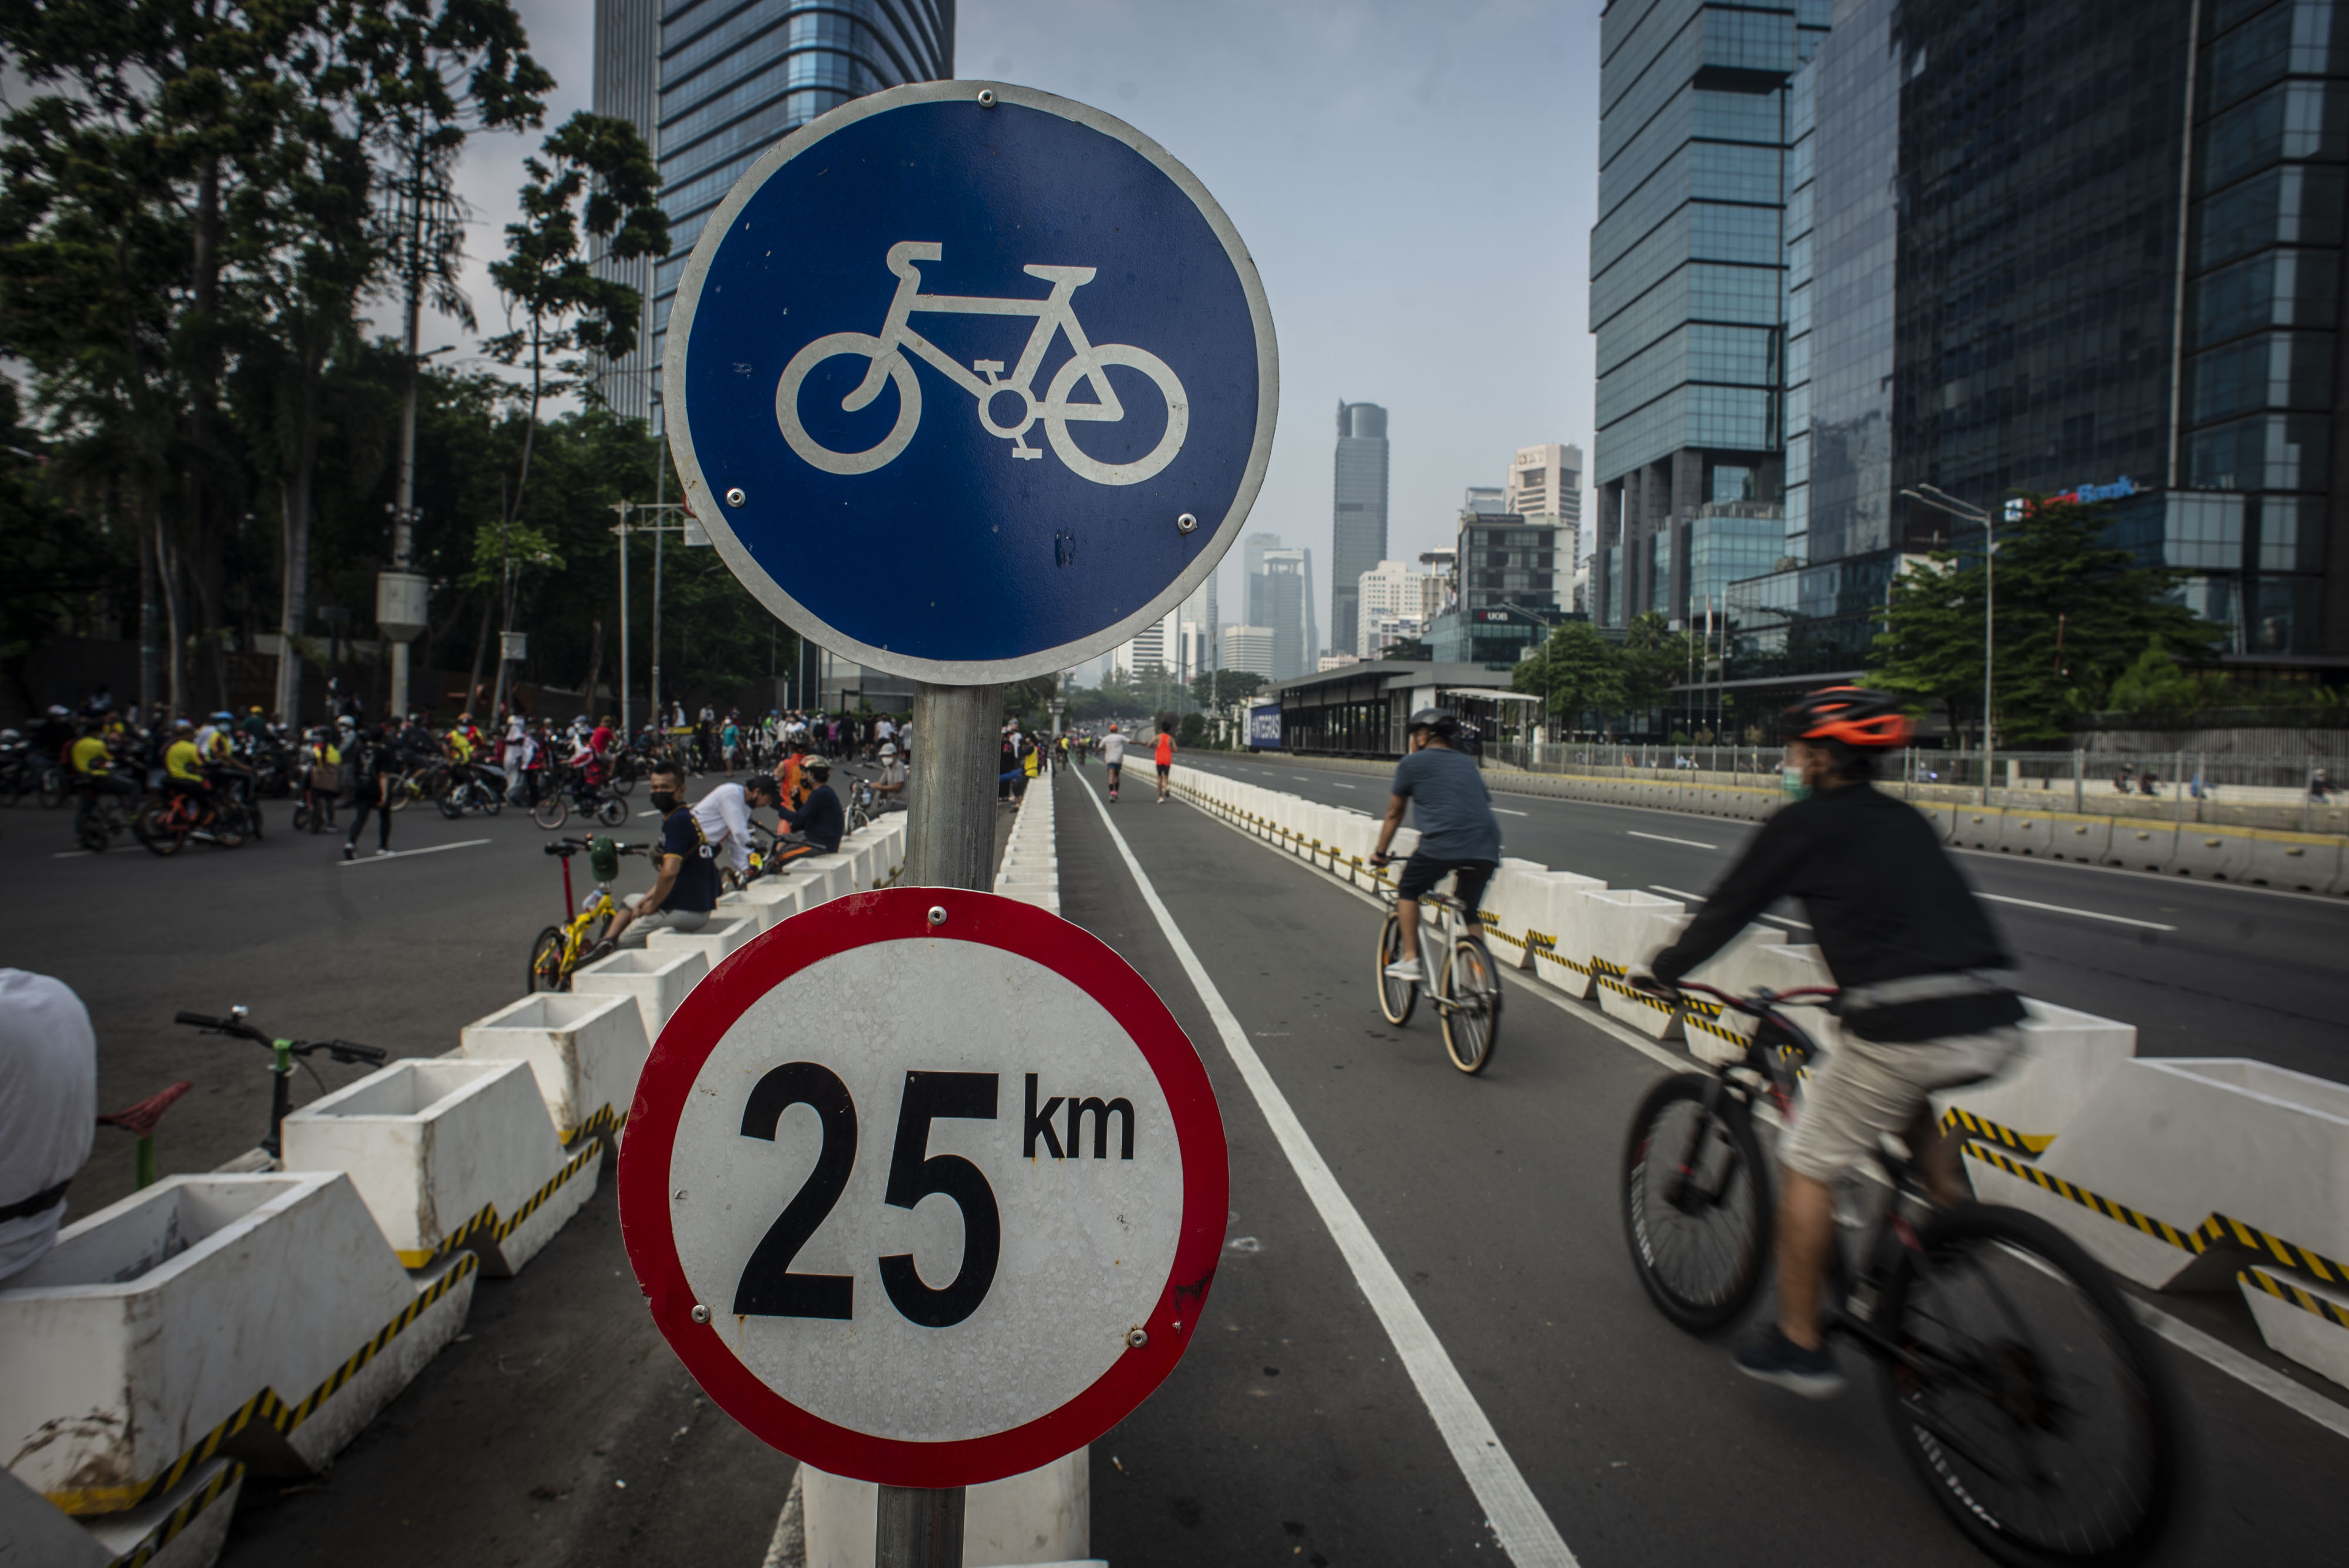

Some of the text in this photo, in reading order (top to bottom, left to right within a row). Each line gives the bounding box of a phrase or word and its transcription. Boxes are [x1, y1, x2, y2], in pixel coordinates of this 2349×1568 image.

[1487, 611, 1508, 621] UOB
[733, 1061, 1135, 1328] 25 km
